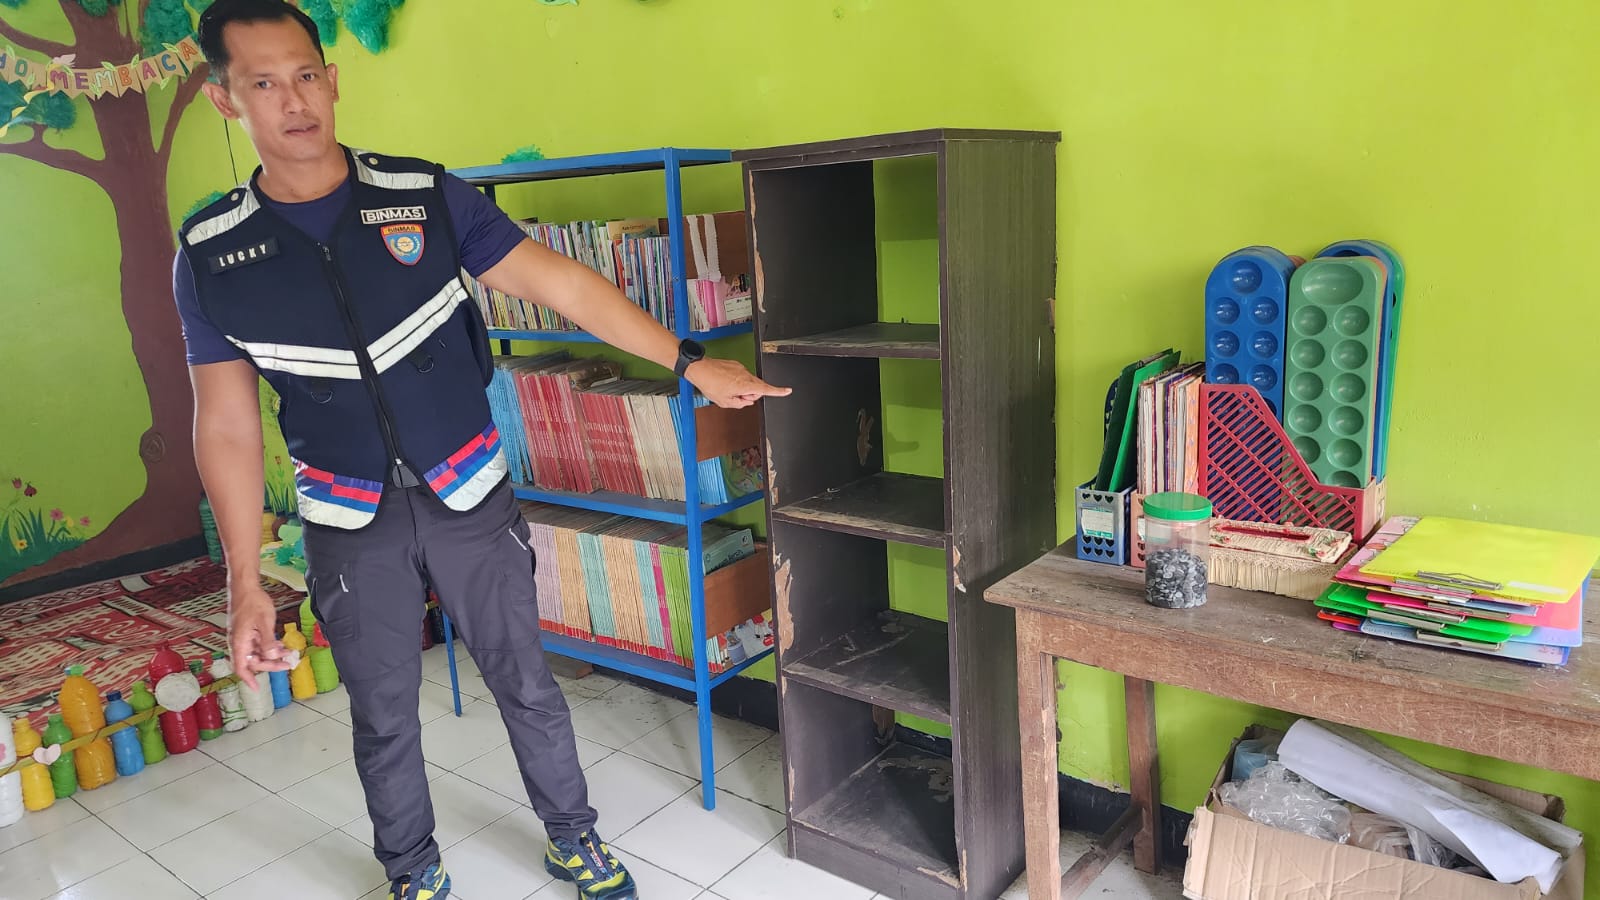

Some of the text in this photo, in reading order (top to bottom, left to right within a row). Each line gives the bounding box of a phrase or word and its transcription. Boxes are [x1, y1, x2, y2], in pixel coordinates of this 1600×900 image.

[50, 42, 198, 90] MEMBACA
[366, 208, 422, 222] BINMAS
[218, 243, 267, 267] LUCKY
